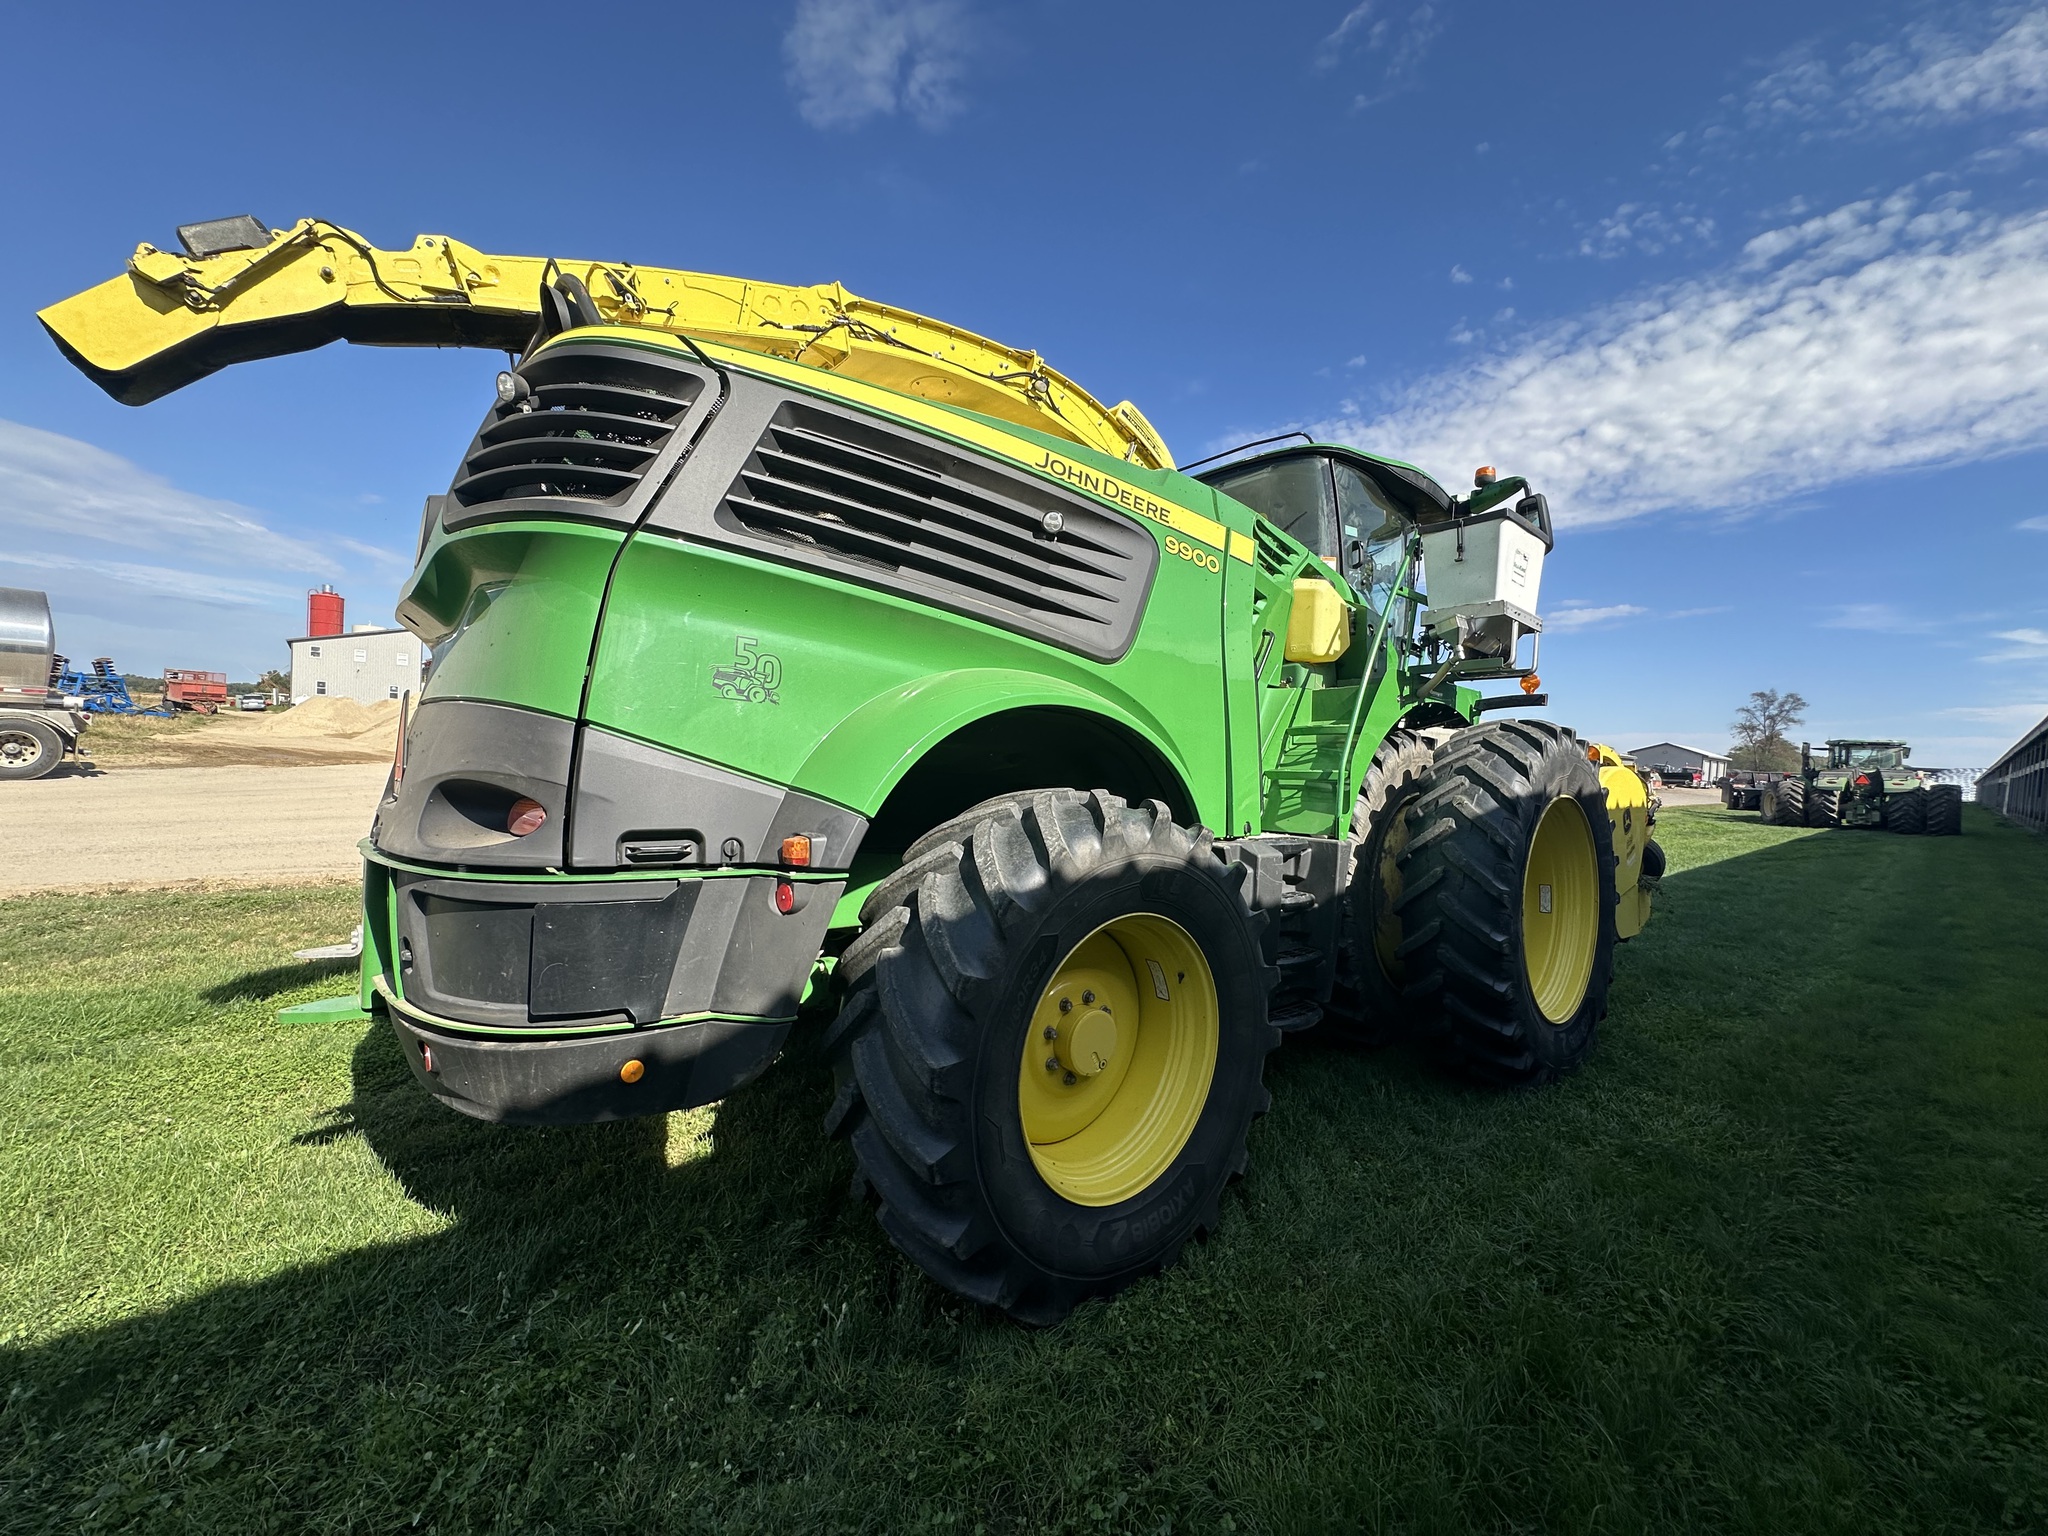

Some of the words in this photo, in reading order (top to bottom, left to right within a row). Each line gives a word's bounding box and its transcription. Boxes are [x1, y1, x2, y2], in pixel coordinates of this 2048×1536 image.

[1034, 452, 1099, 493] JOHN
[1102, 478, 1171, 525] DEERE
[1164, 535, 1220, 574] 9900
[734, 635, 782, 690] 50
